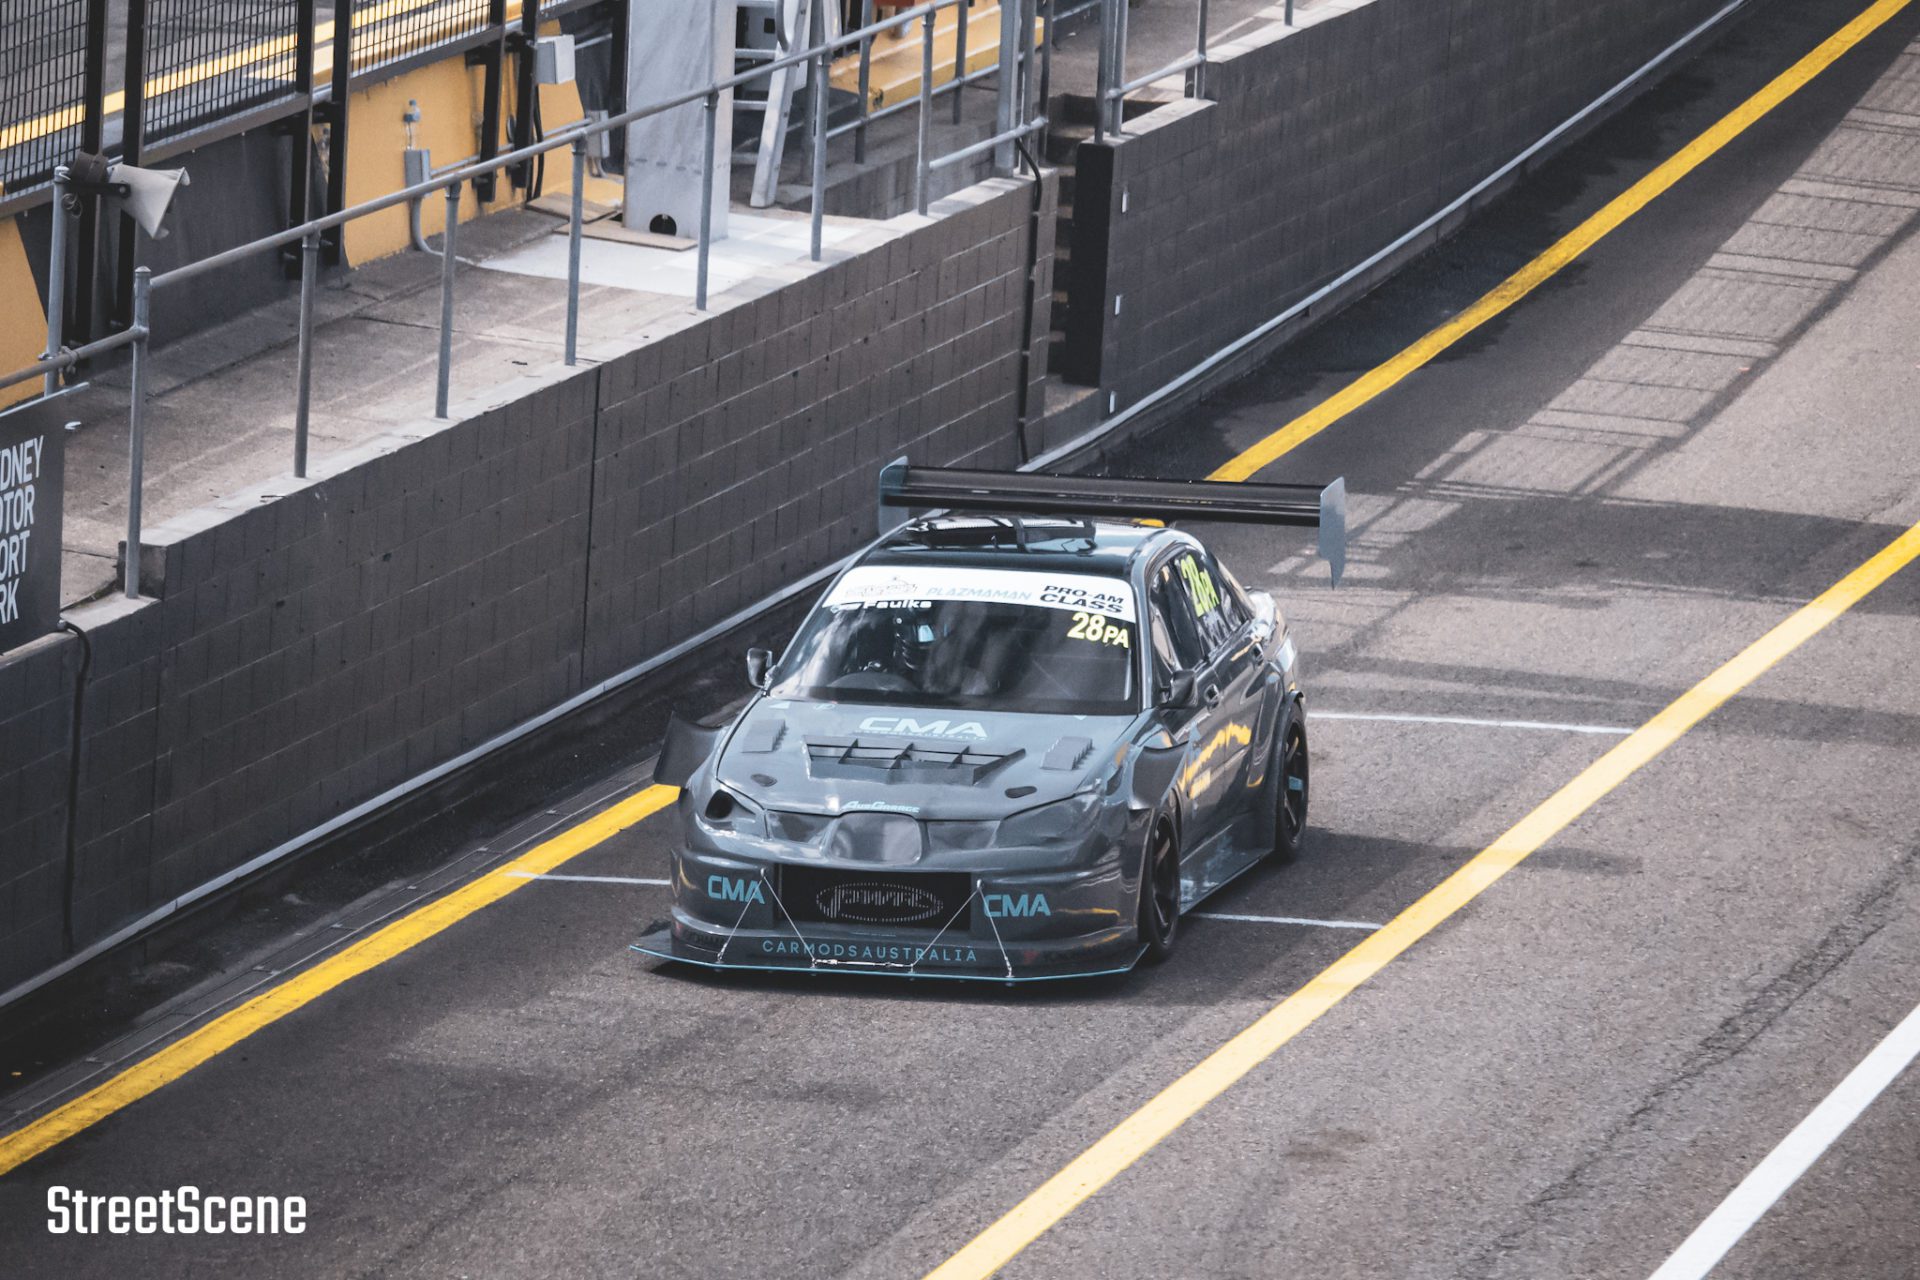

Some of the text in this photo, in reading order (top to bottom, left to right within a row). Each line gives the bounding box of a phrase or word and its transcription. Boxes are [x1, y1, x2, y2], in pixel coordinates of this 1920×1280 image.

[0, 435, 44, 491] DNEY
[926, 586, 1033, 601] PLAZMAMAN
[1039, 593, 1123, 614] CLASS
[1043, 585, 1125, 604] PRO-AM
[858, 716, 988, 739] CMA
[707, 875, 765, 905] CMA
[982, 893, 1051, 917] CMA
[762, 939, 977, 962] CARMODSAUSTRALIA
